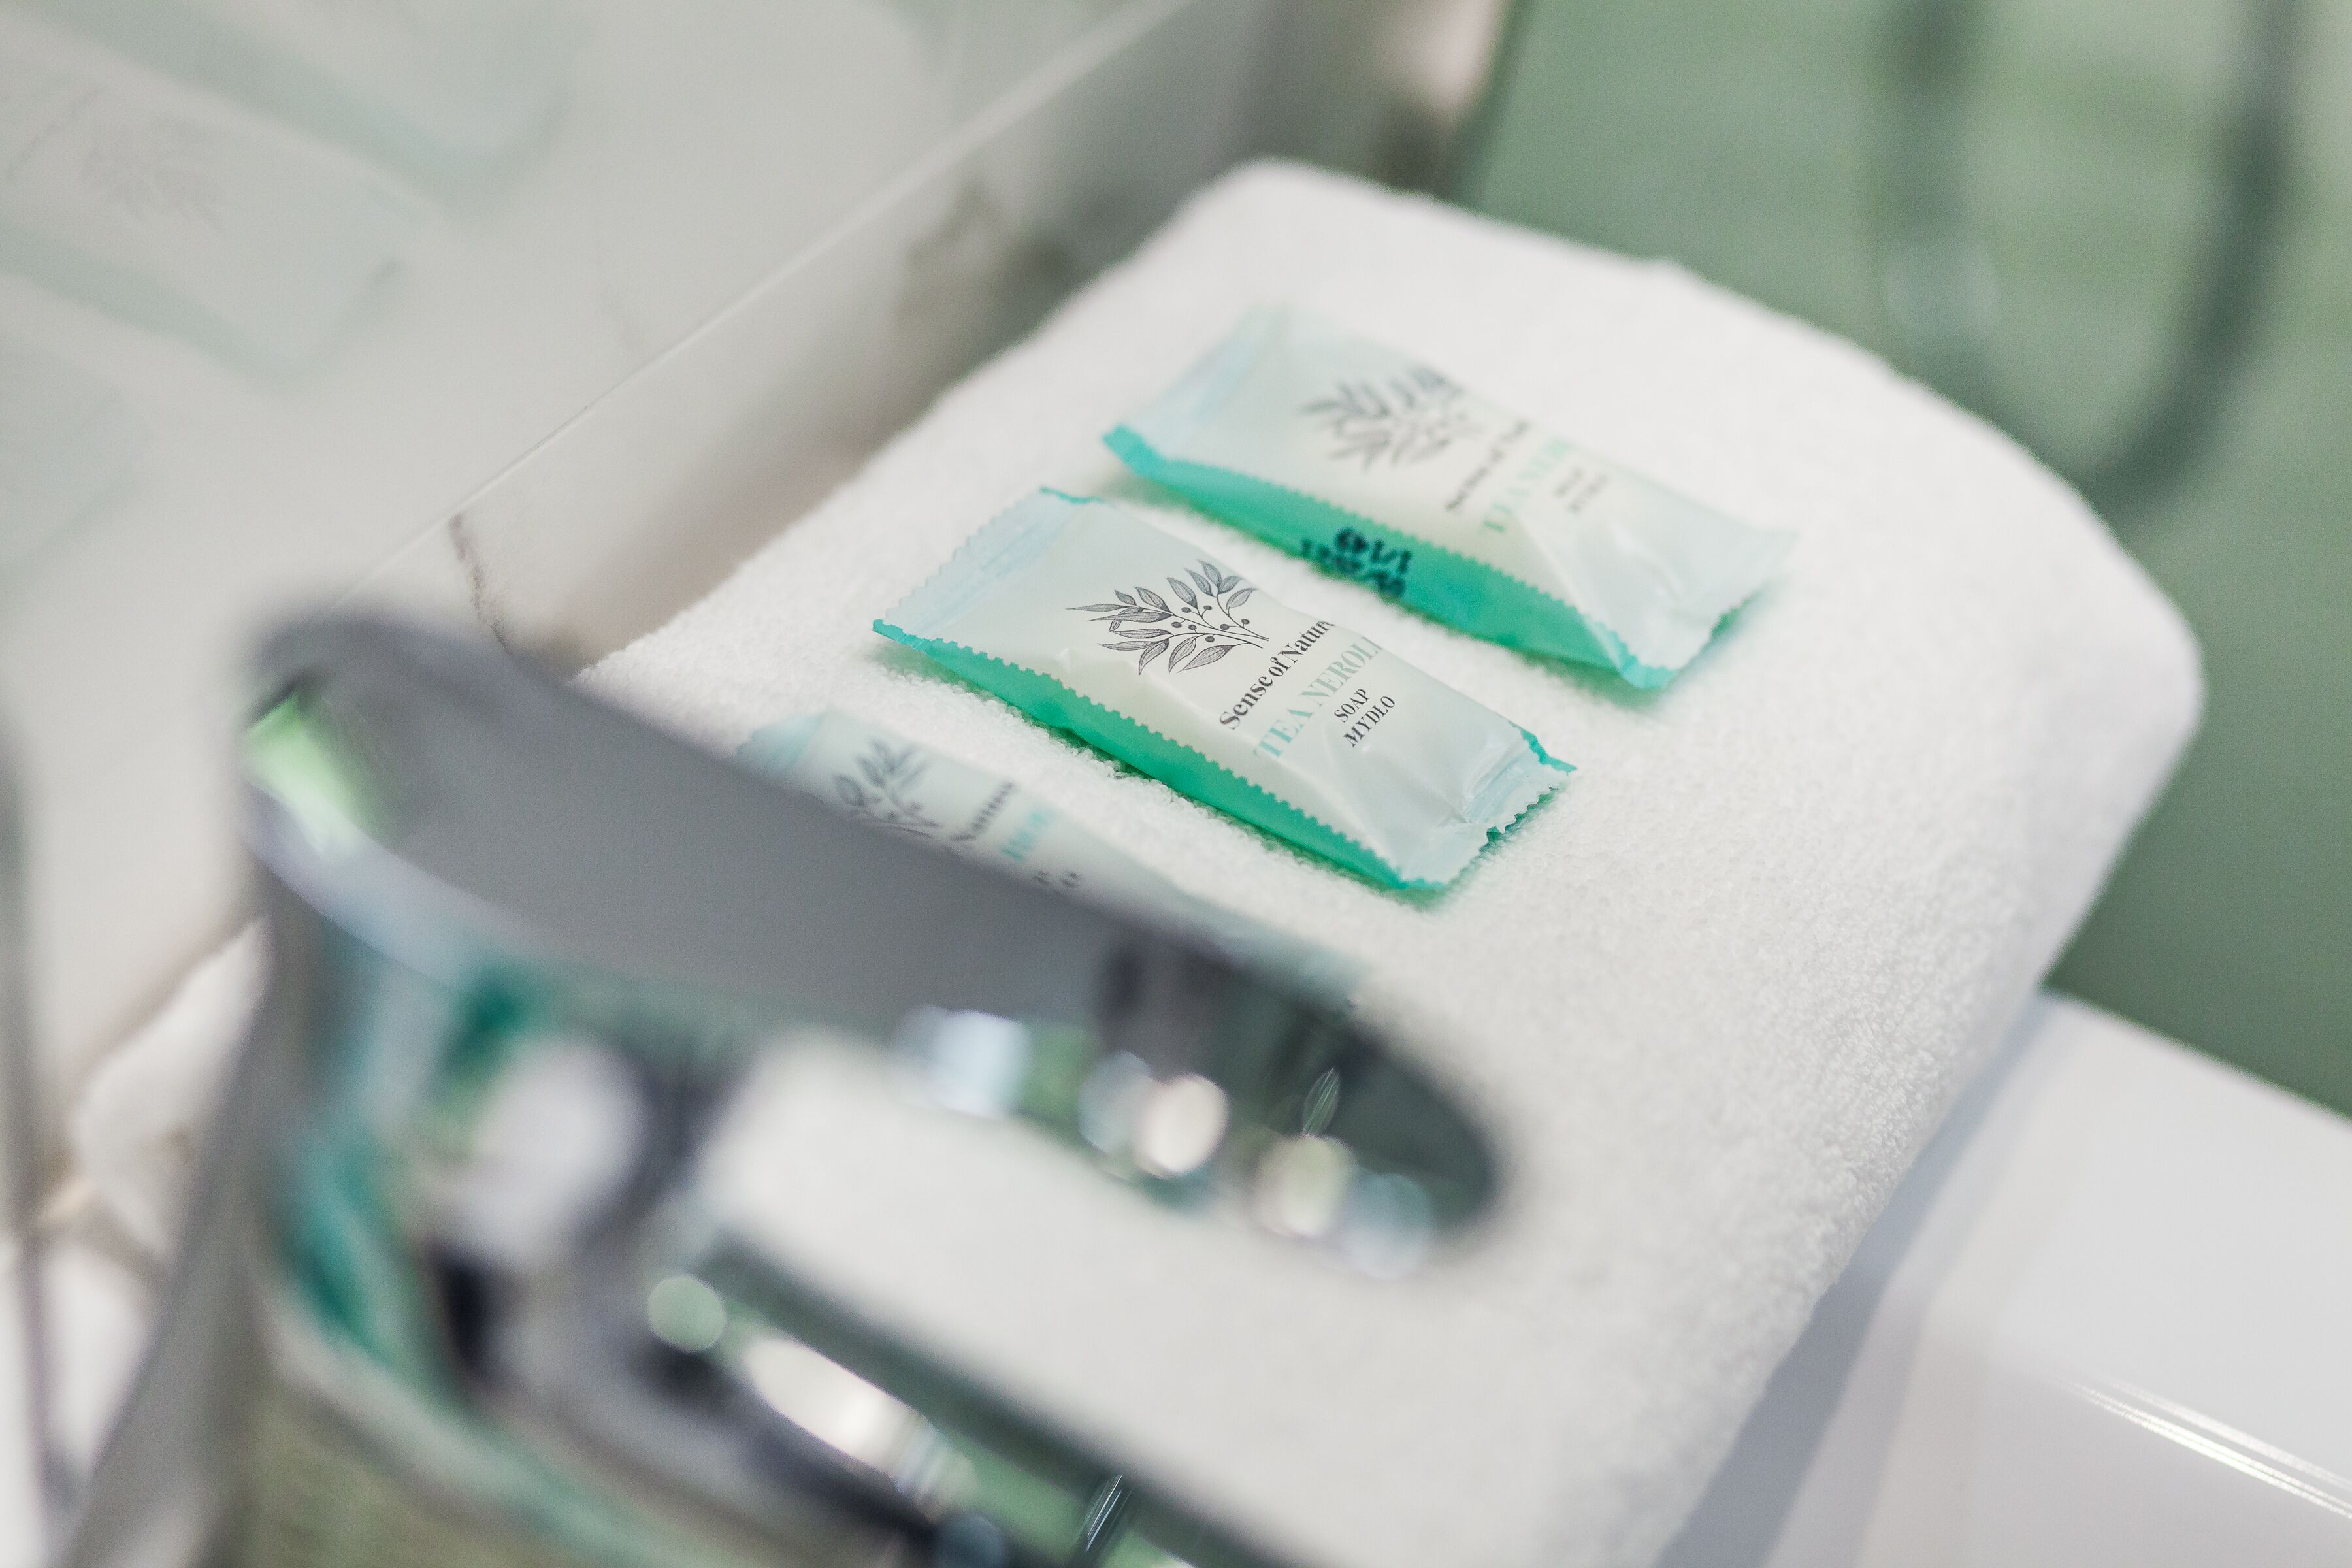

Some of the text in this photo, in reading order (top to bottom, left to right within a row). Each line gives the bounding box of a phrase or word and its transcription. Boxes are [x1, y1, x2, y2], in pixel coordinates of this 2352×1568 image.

[1219, 676, 1274, 730] Sense
[1268, 656, 1292, 677] of
[1334, 688, 1370, 723] SOAP
[1252, 708, 1314, 757] TEA
[1343, 695, 1396, 747] MYDŁO
